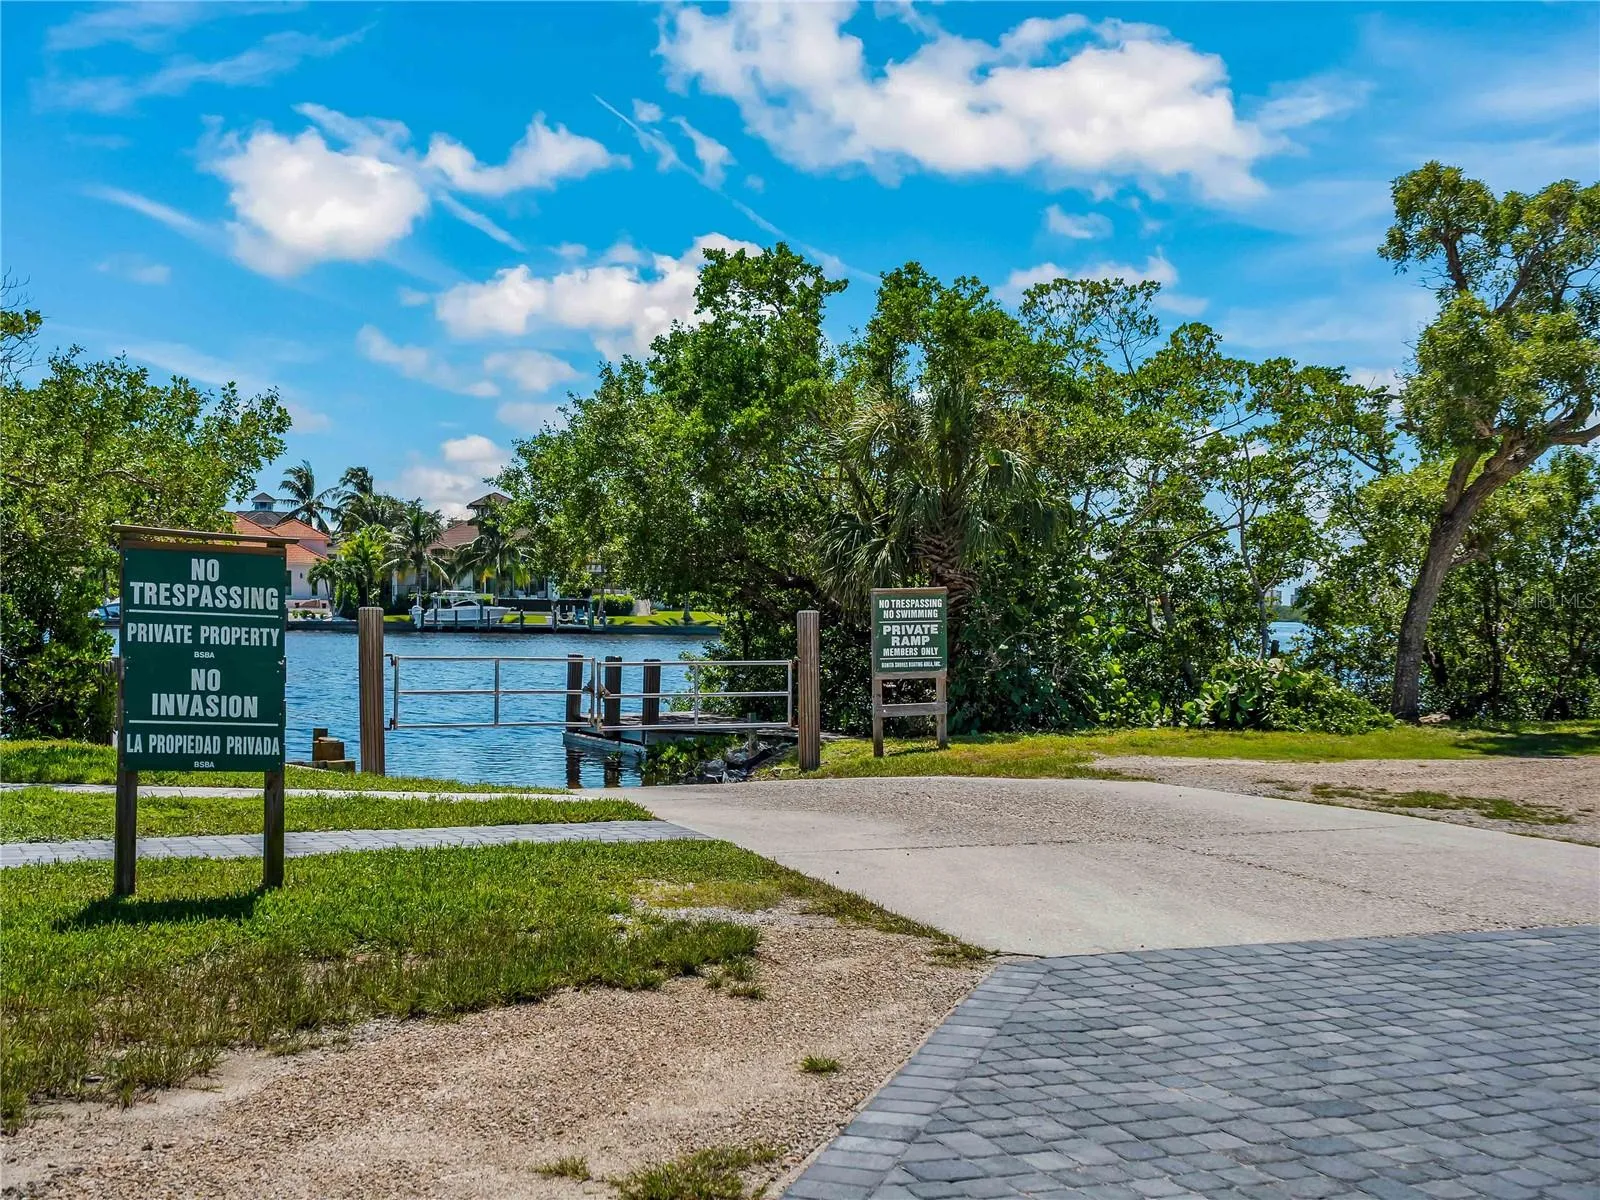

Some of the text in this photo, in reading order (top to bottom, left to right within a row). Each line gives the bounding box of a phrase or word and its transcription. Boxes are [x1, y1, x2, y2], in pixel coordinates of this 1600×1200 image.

[191, 558, 220, 582] NO
[129, 581, 279, 611] TRESPASSING
[878, 598, 943, 609] NO TRESPASSING
[883, 609, 939, 619] NO SWIMMING
[127, 622, 280, 647] PRIVATE PROPERTY
[882, 624, 939, 635] PRIVATE
[891, 635, 930, 646] RAMP
[193, 651, 215, 659] BSBA
[882, 646, 939, 657] MEMBERS ONLY
[191, 668, 221, 692] NO
[151, 693, 258, 718] INVASION
[126, 733, 280, 756] LA PROPIEDAD PRIVADA
[193, 760, 215, 769] BSBA
